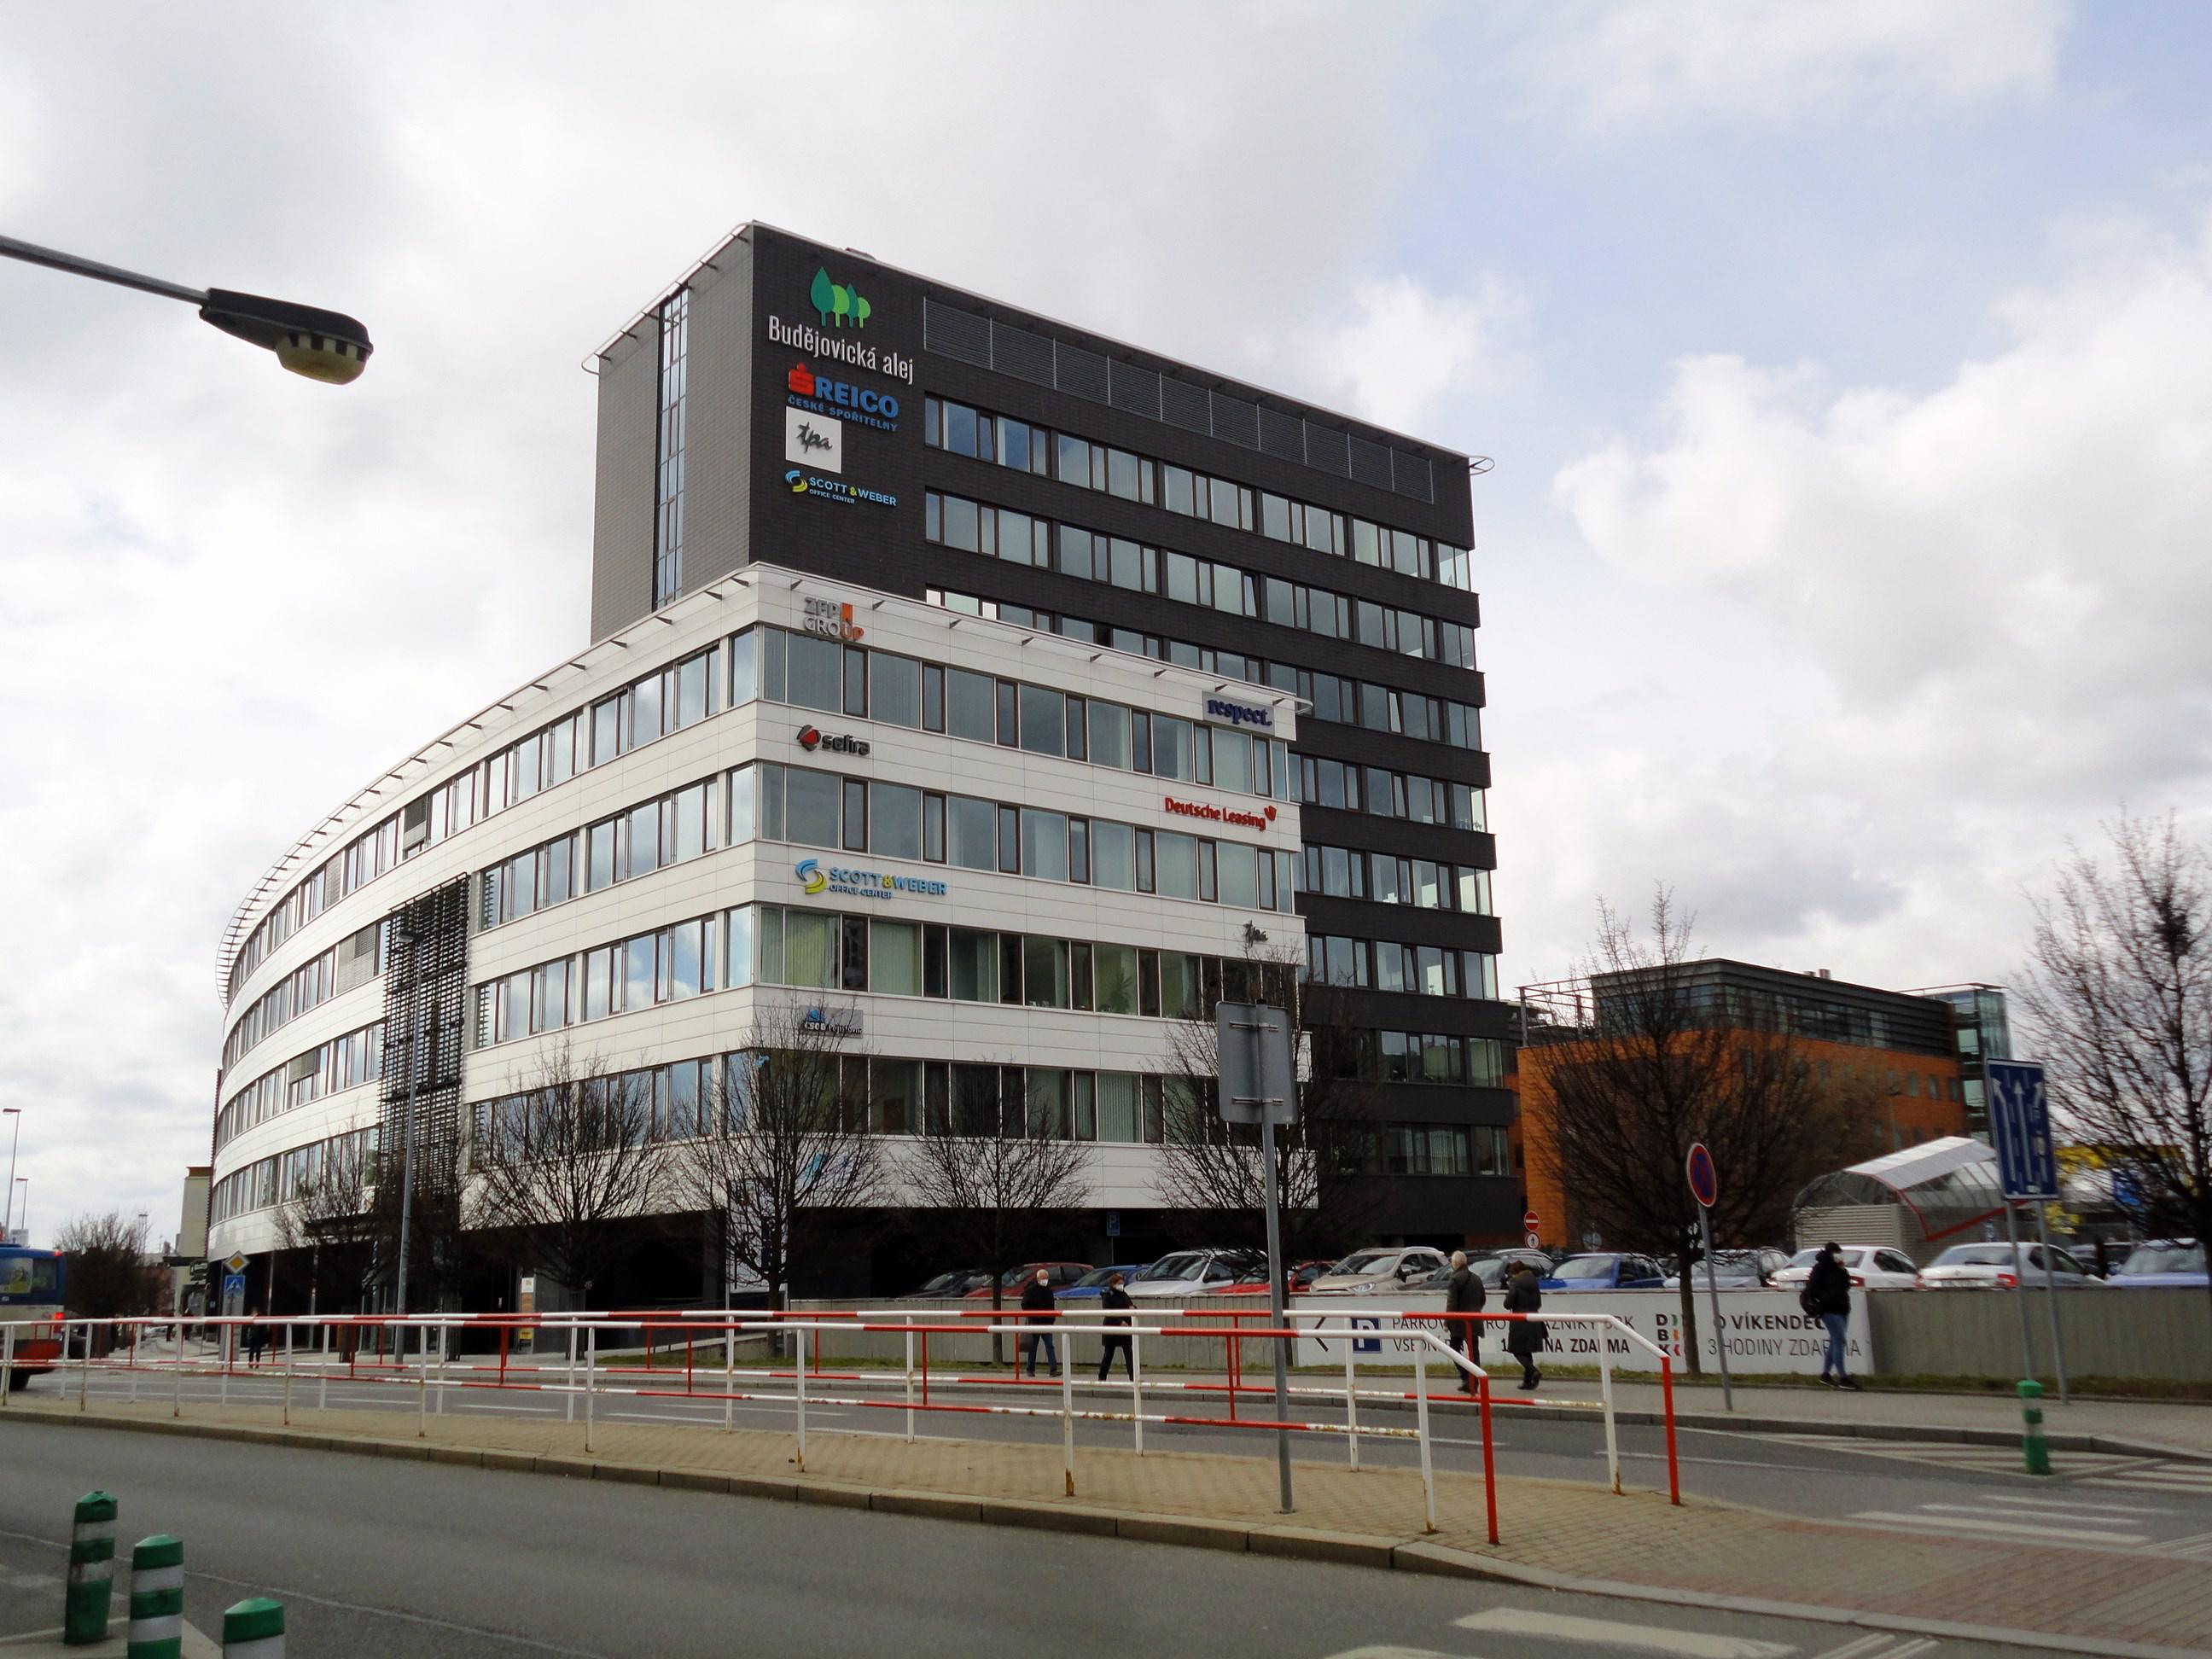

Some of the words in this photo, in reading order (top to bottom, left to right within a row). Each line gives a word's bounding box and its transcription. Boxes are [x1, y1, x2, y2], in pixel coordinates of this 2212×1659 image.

[769, 315, 876, 370] Budějovická
[882, 352, 914, 384] alej
[815, 375, 899, 418] REICO
[809, 488, 830, 498] OFFICE
[832, 493, 855, 504] CENTER
[1165, 797, 1221, 821] Deutsche
[1222, 806, 1266, 831] Leasing
[1731, 1312, 1826, 1330] VÍKENDEC
[1708, 1338, 1718, 1355] 3
